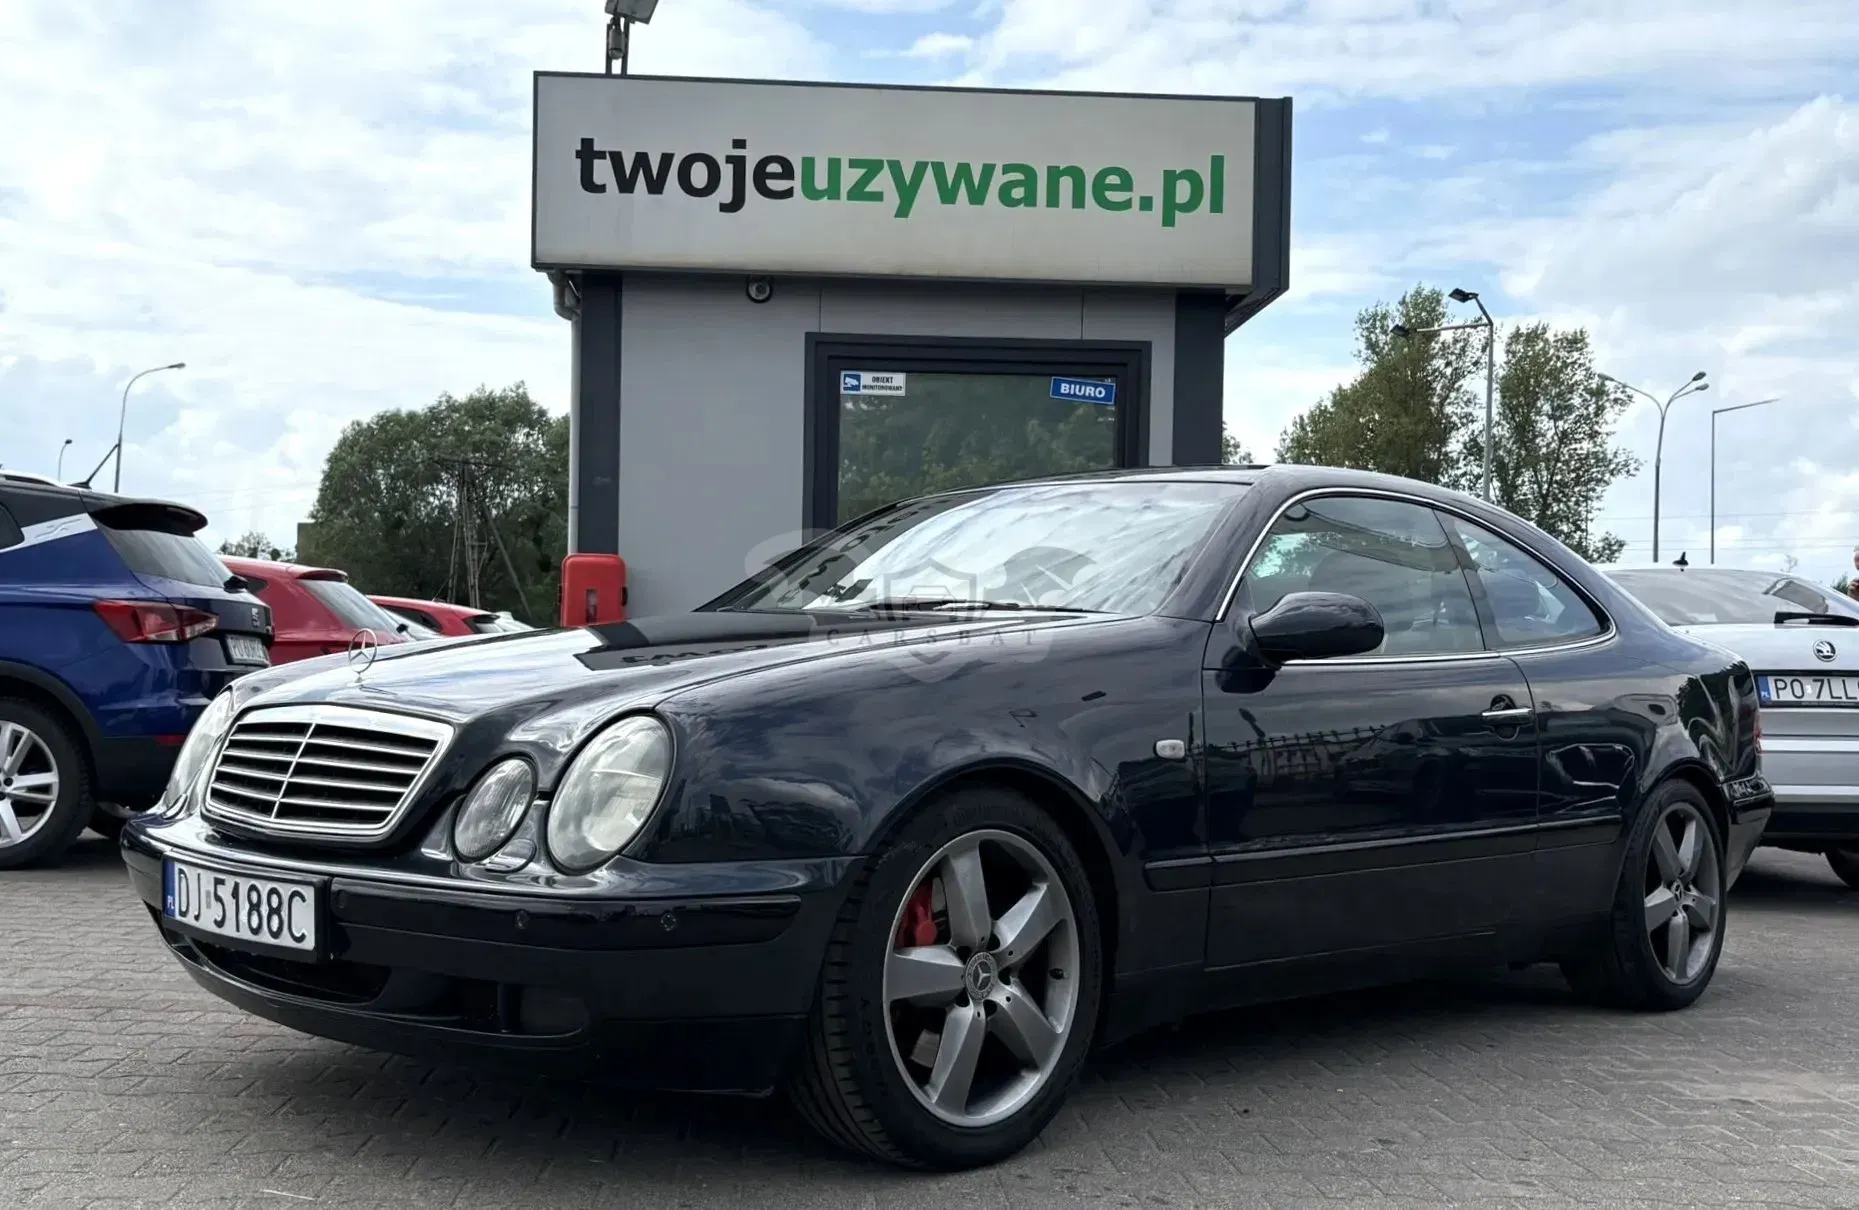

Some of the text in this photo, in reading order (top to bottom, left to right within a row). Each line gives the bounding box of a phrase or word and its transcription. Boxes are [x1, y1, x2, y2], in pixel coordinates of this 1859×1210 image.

[575, 138, 1224, 227] twojeuzywane.pl
[1060, 383, 1106, 398] BIURO
[1812, 678, 1859, 700] 7LL
[178, 867, 307, 944] DJ 5188C
